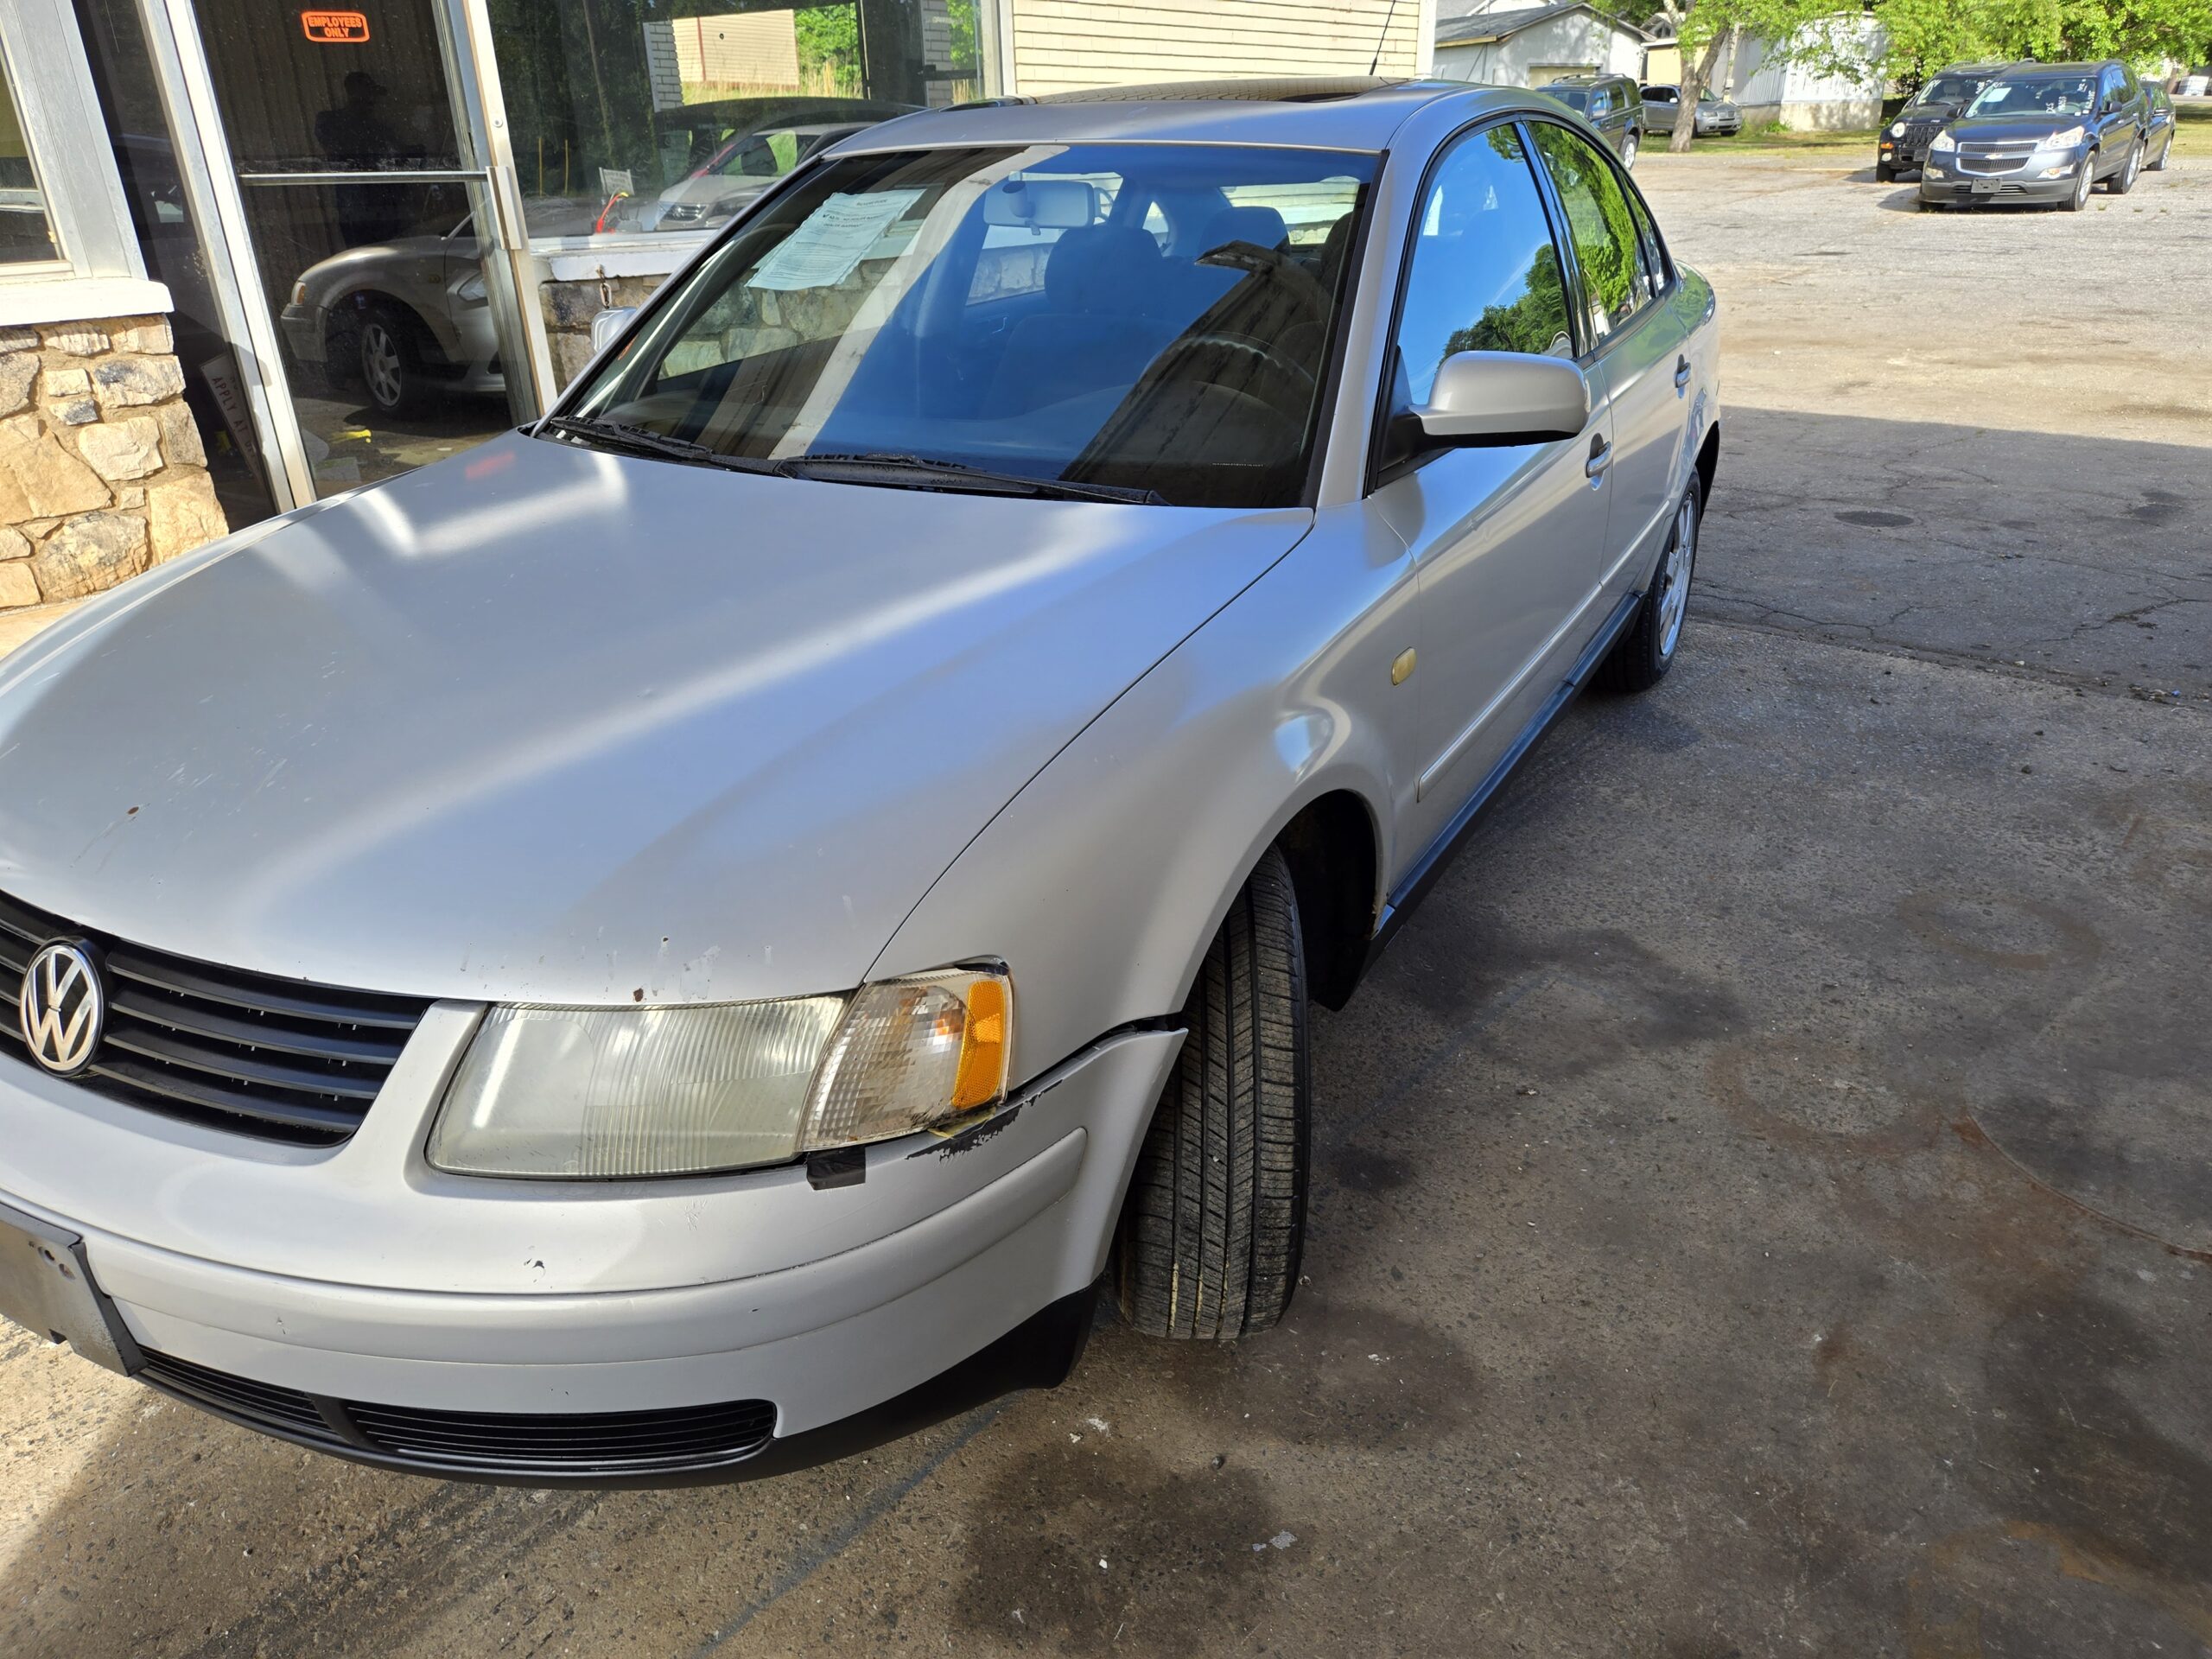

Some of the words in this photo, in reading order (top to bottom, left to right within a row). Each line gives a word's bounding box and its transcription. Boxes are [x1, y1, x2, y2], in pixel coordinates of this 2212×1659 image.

[308, 16, 362, 27] EMPLOYEES
[324, 28, 350, 38] ONLY
[213, 378, 237, 411] APPLY
[234, 420, 248, 432] AT
[22, 945, 100, 1070] VW
